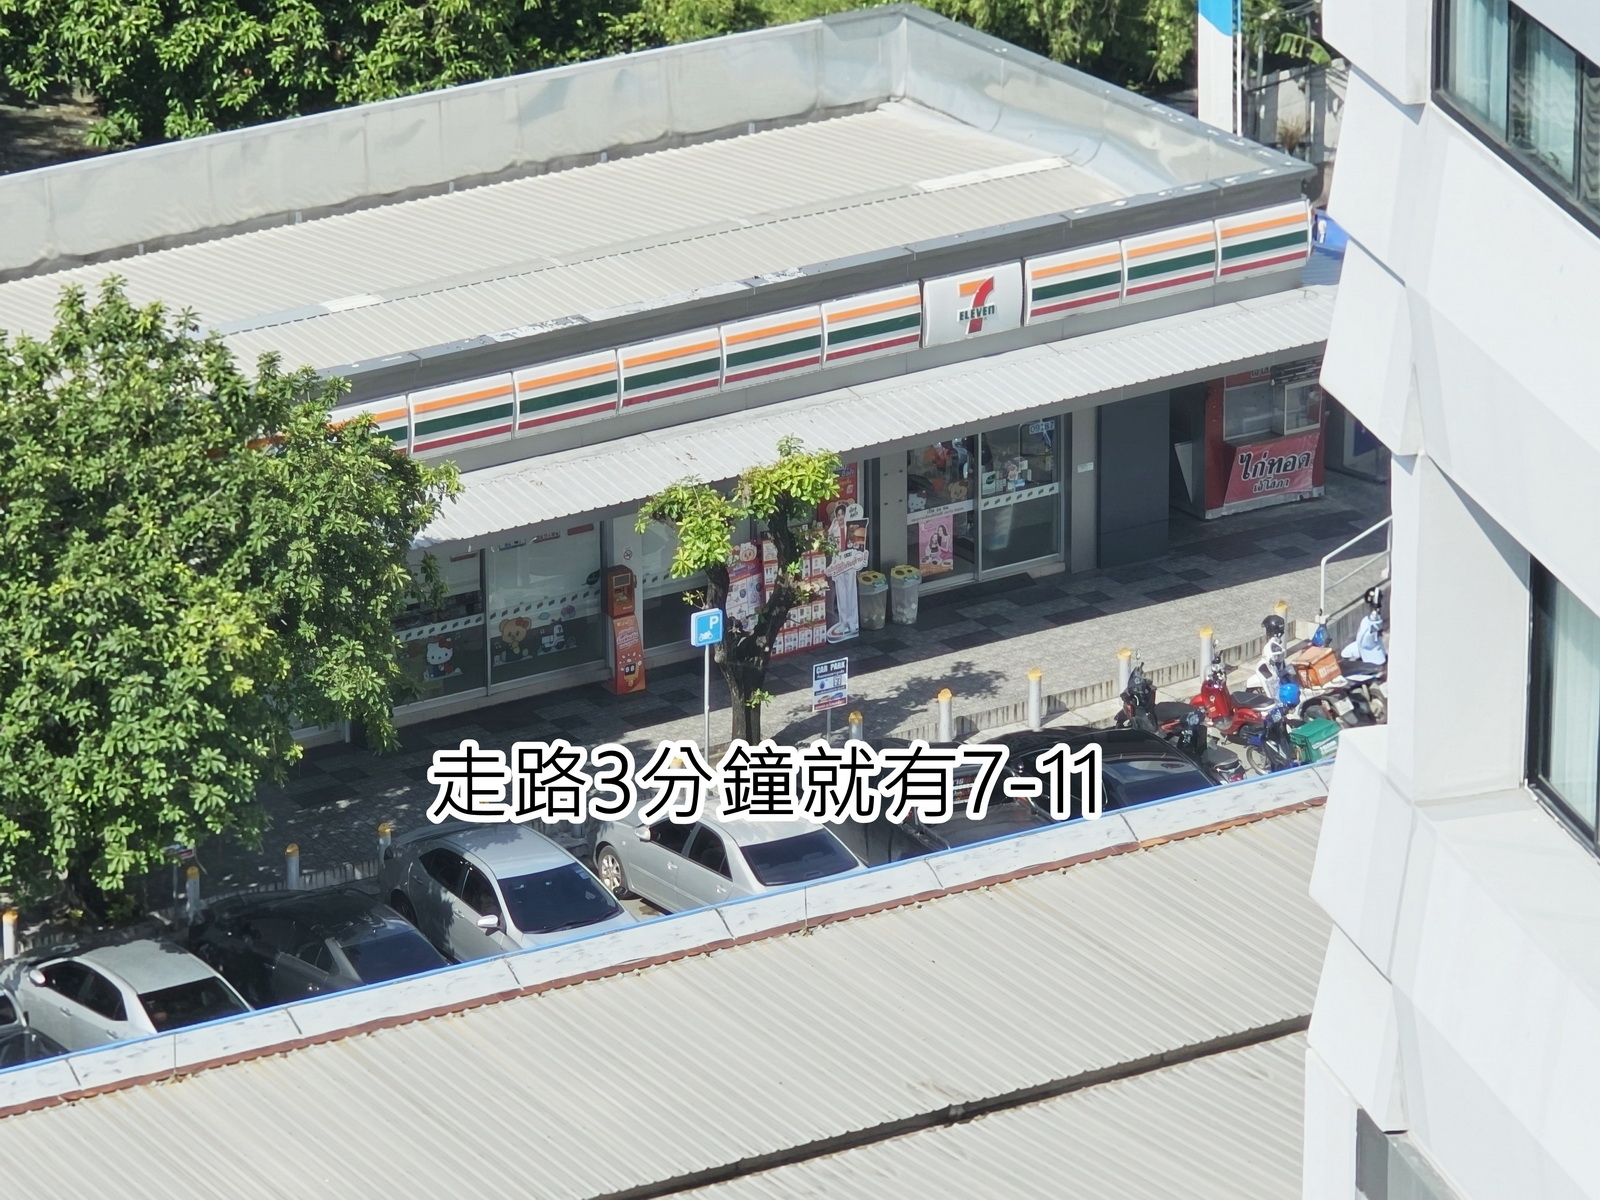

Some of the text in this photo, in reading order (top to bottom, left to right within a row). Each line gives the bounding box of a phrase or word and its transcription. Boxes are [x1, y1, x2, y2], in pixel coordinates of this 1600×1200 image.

[959, 276, 995, 334] 7
[1239, 450, 1312, 480] ไก่ทอด
[709, 616, 719, 629] P
[816, 661, 845, 674] CAR PARK
